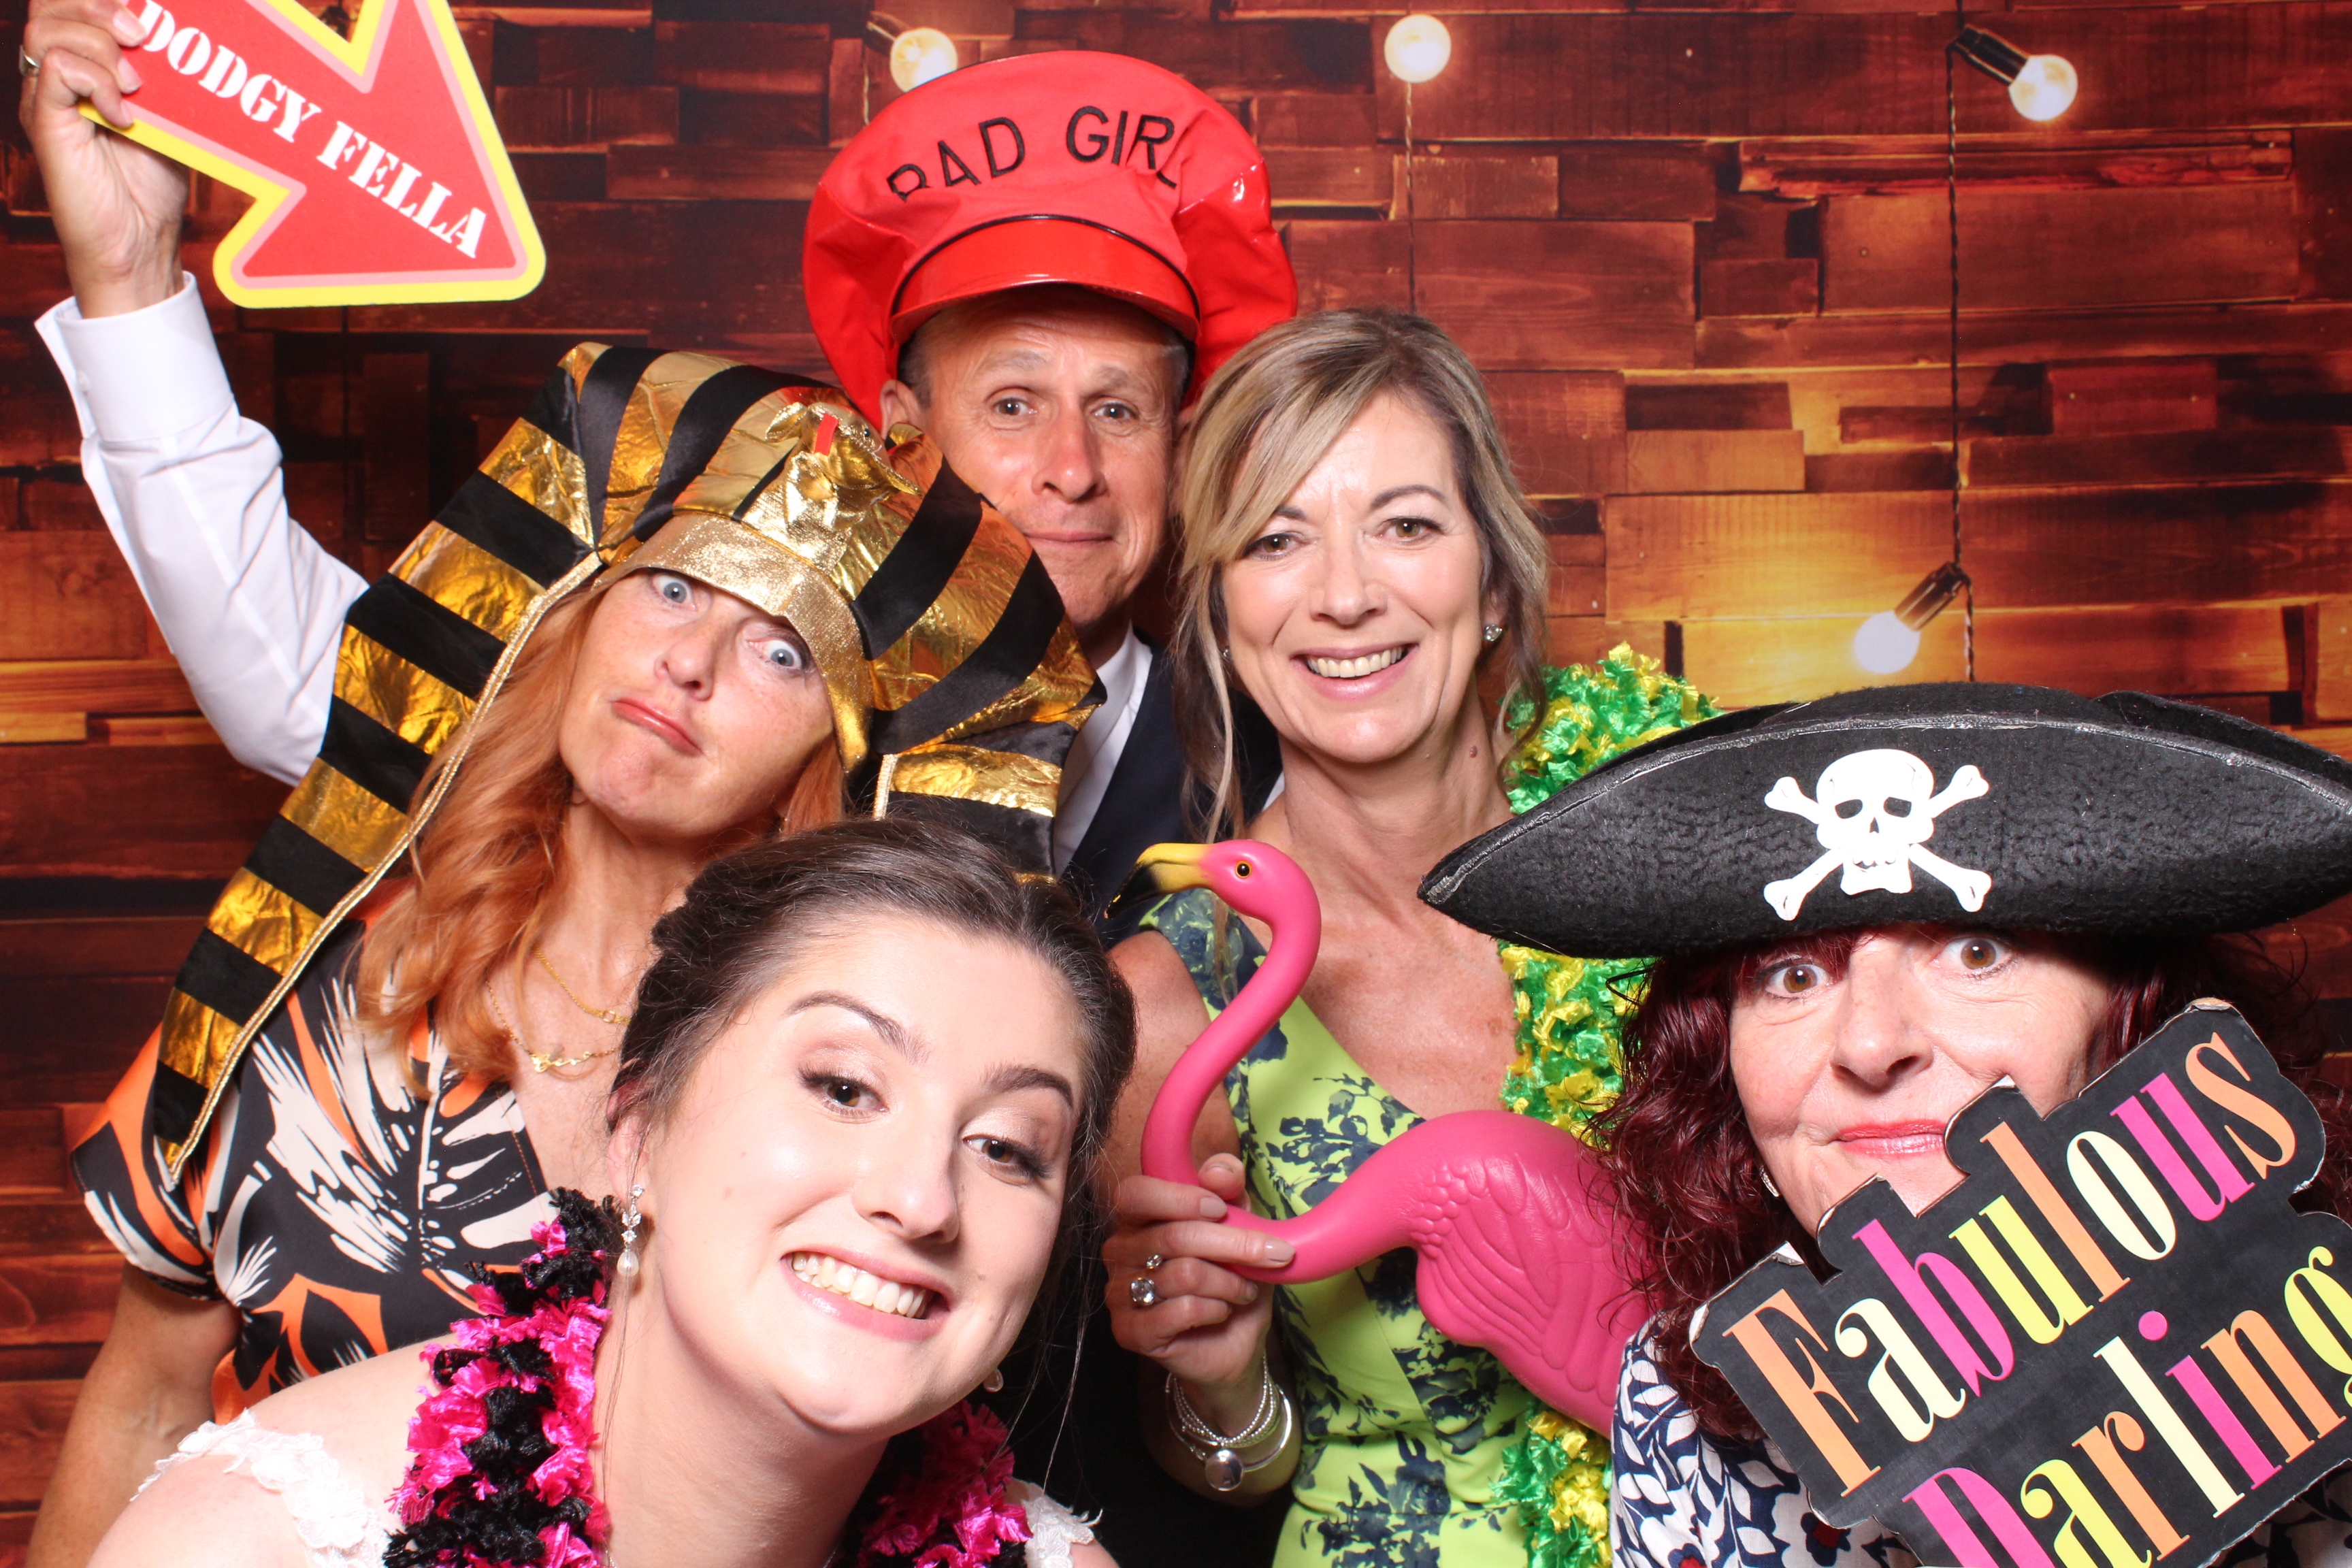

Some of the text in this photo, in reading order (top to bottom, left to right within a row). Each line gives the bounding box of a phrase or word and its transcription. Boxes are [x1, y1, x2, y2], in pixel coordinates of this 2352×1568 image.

[137, 0, 487, 259] DODGY FELLA
[1722, 1031, 2297, 1498] Fabulous
[1901, 1245, 2352, 1568] Darling
